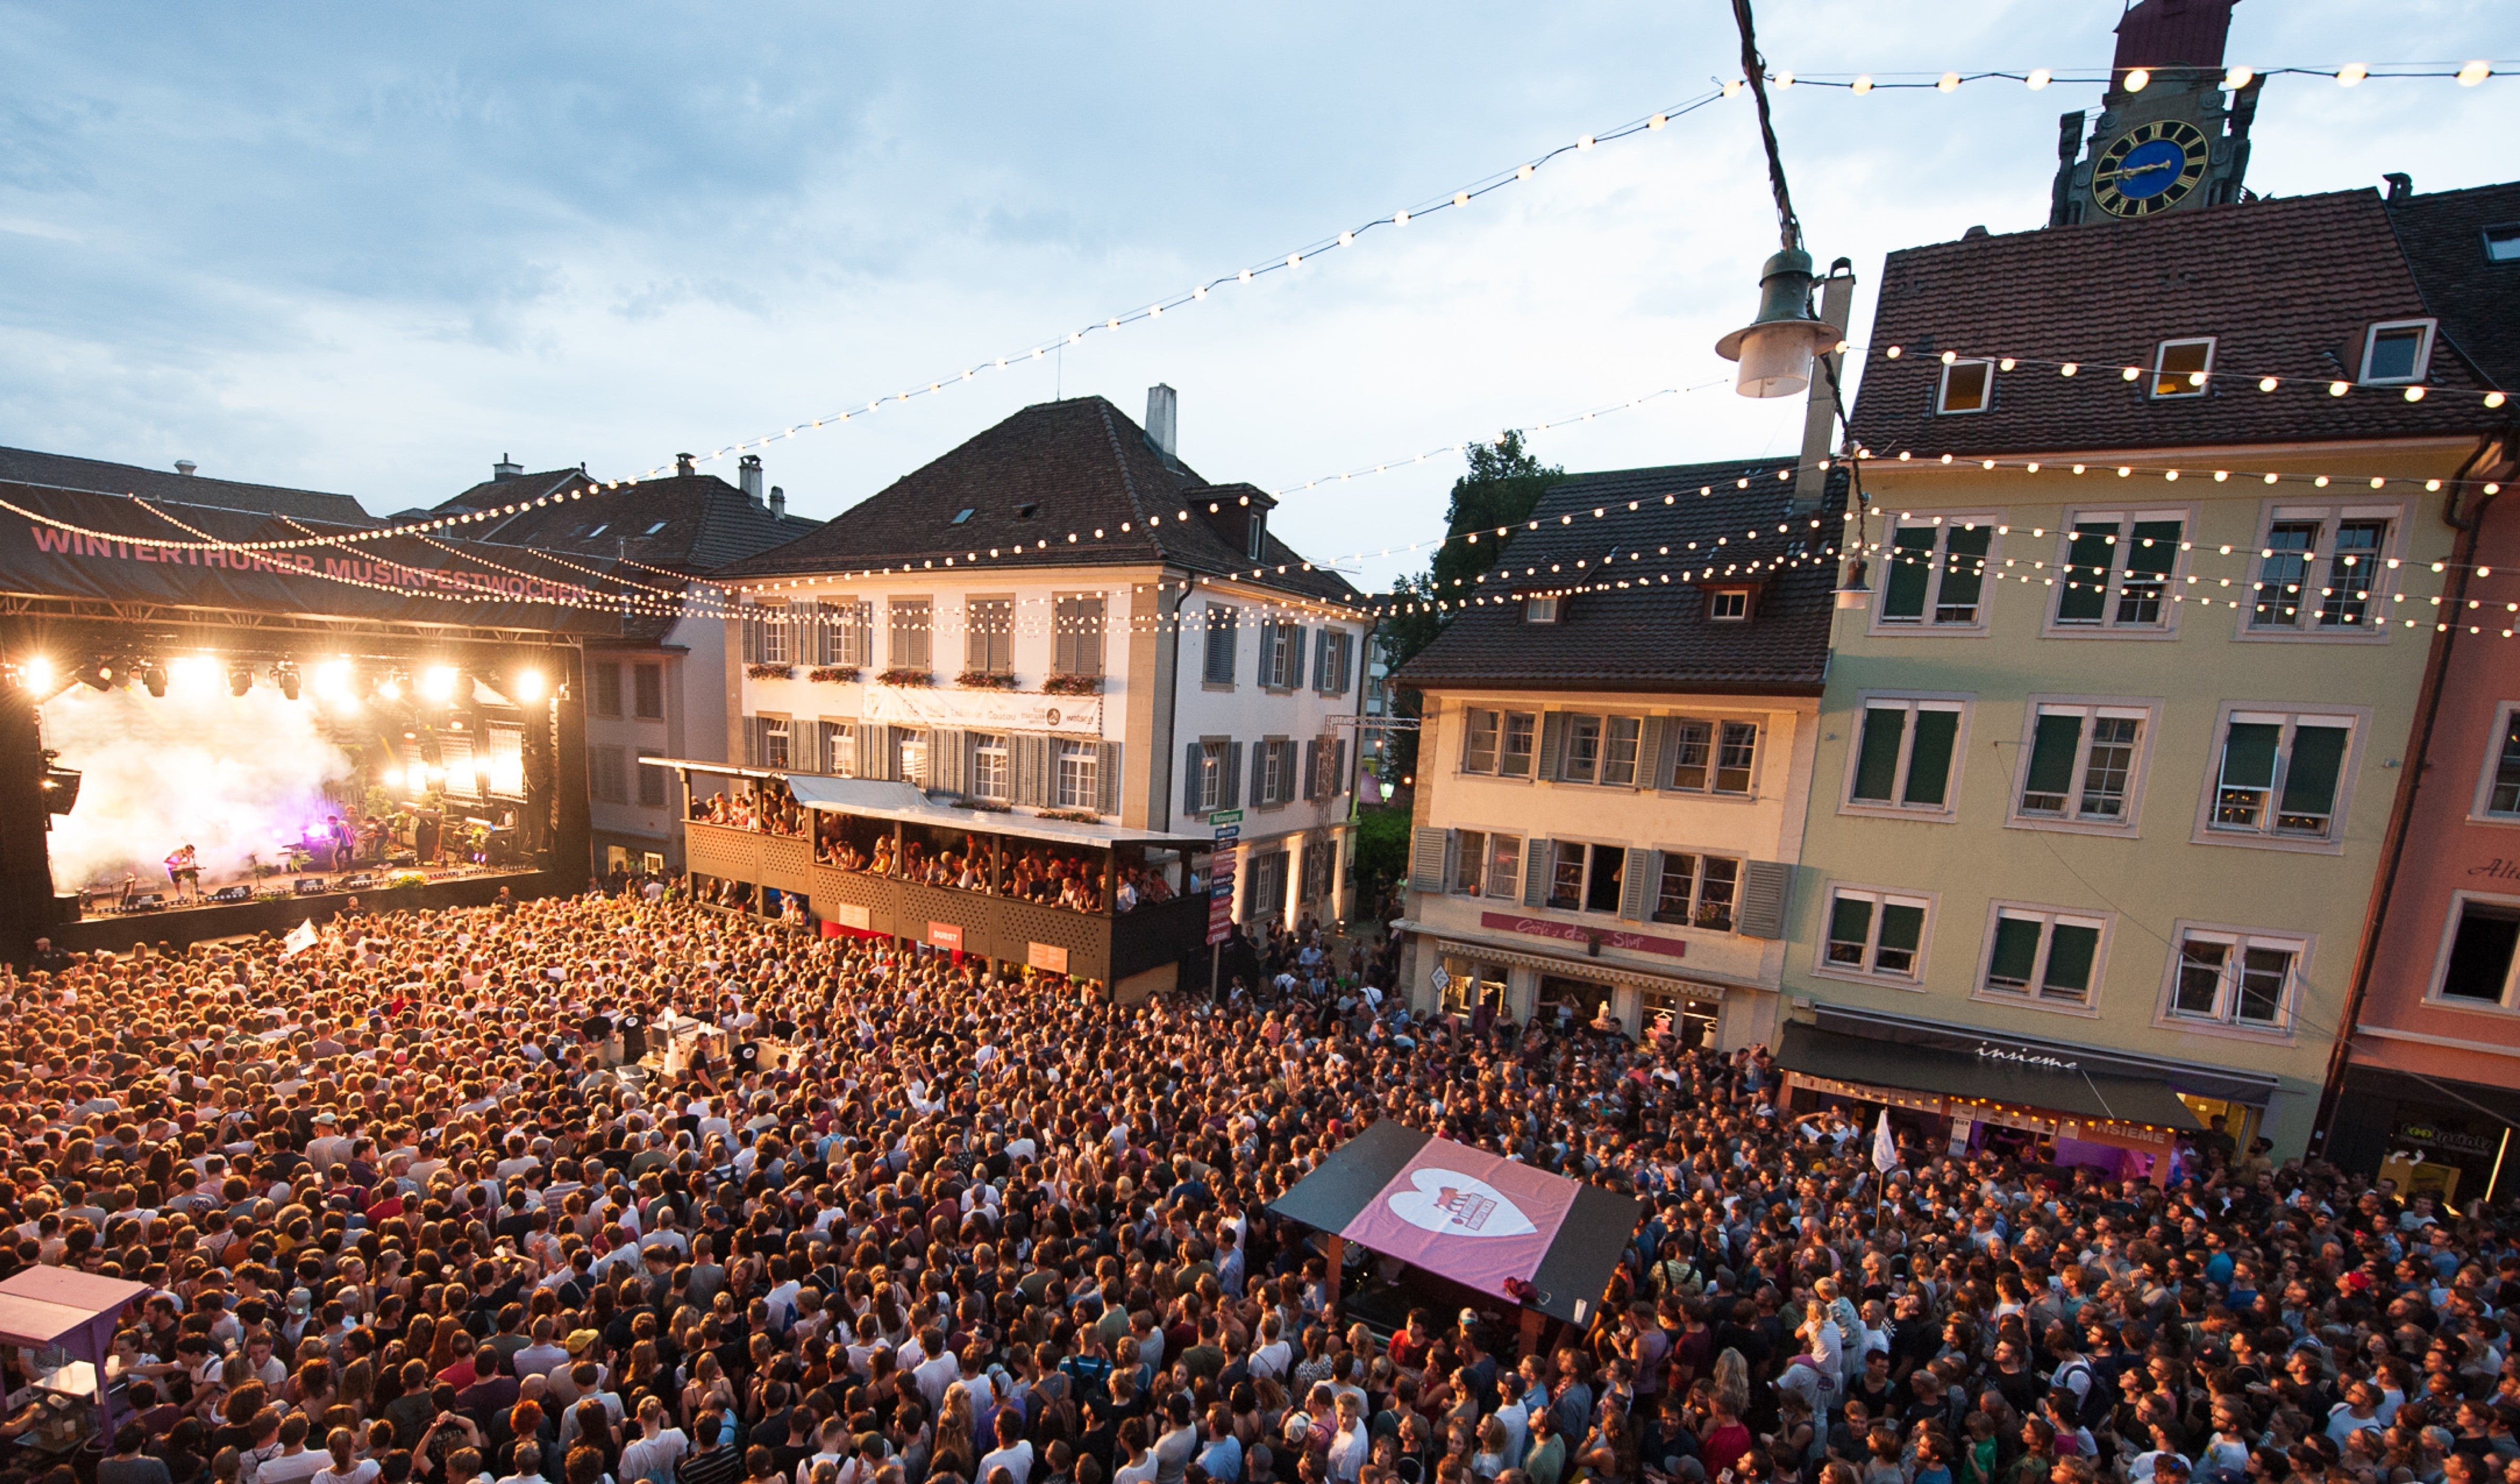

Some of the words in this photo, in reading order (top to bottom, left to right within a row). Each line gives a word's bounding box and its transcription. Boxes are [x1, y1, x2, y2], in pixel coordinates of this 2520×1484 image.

[30, 526, 315, 576] WINTERTHURER
[325, 557, 589, 602] MUSIKFESTWOCHEN
[933, 929, 959, 942] DURST
[1975, 1041, 2077, 1069] insieme
